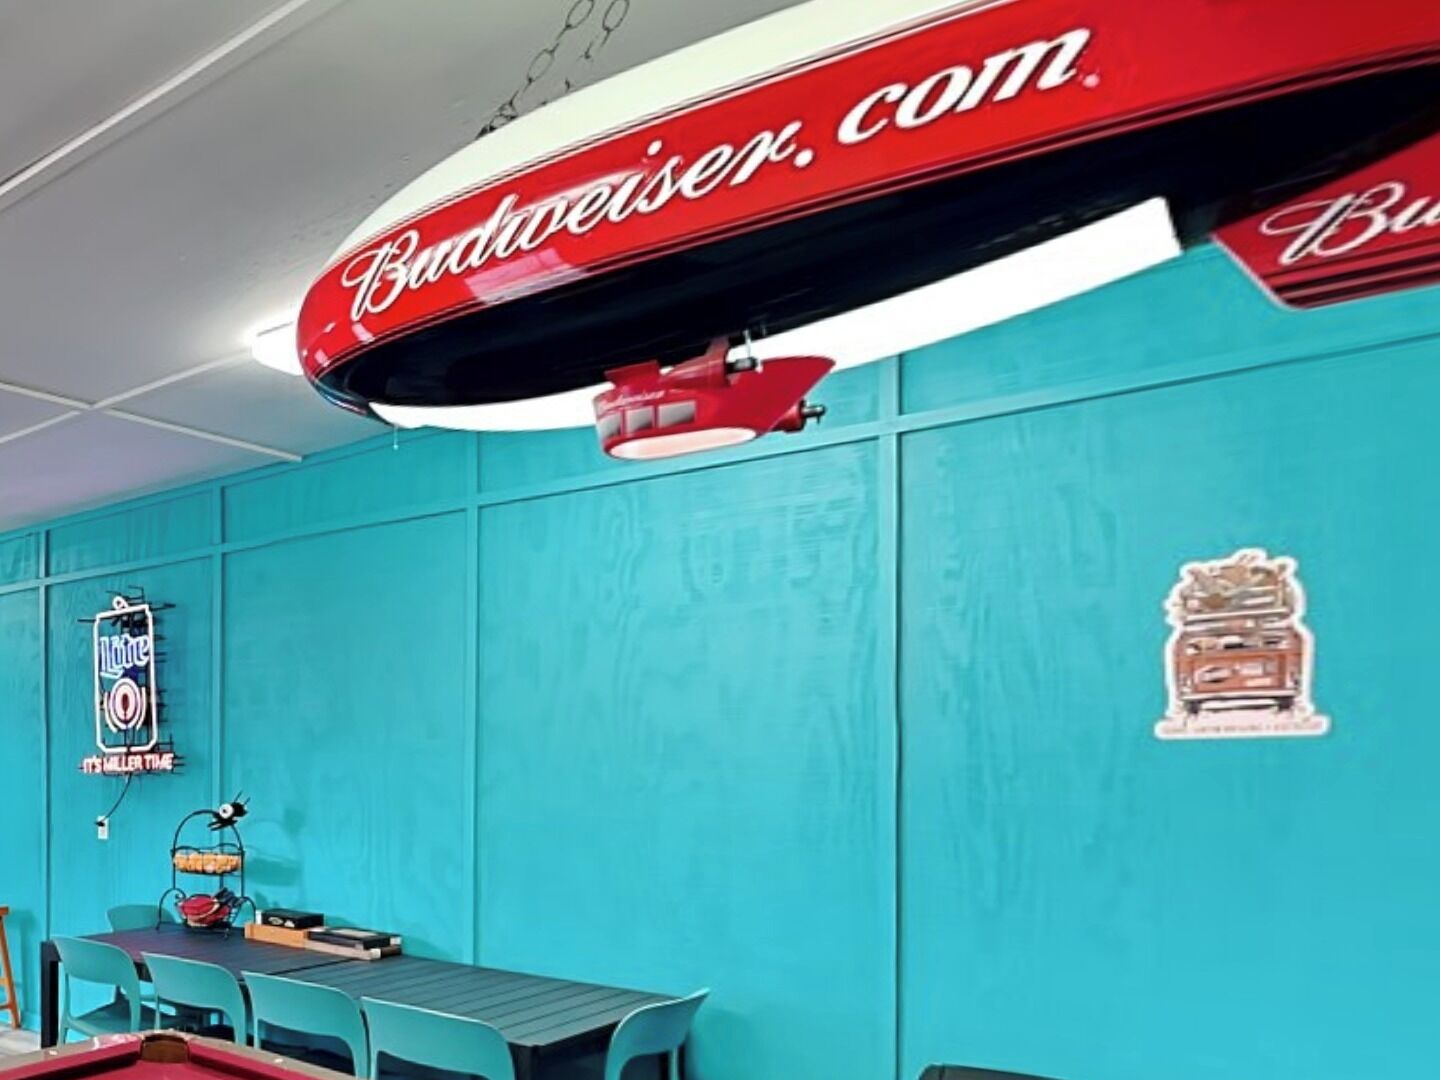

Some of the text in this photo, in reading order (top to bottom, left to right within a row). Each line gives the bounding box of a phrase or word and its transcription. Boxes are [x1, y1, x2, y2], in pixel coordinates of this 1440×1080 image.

[99, 633, 150, 679] Lite
[102, 754, 142, 772] MILLER
[144, 752, 174, 770] TIME
